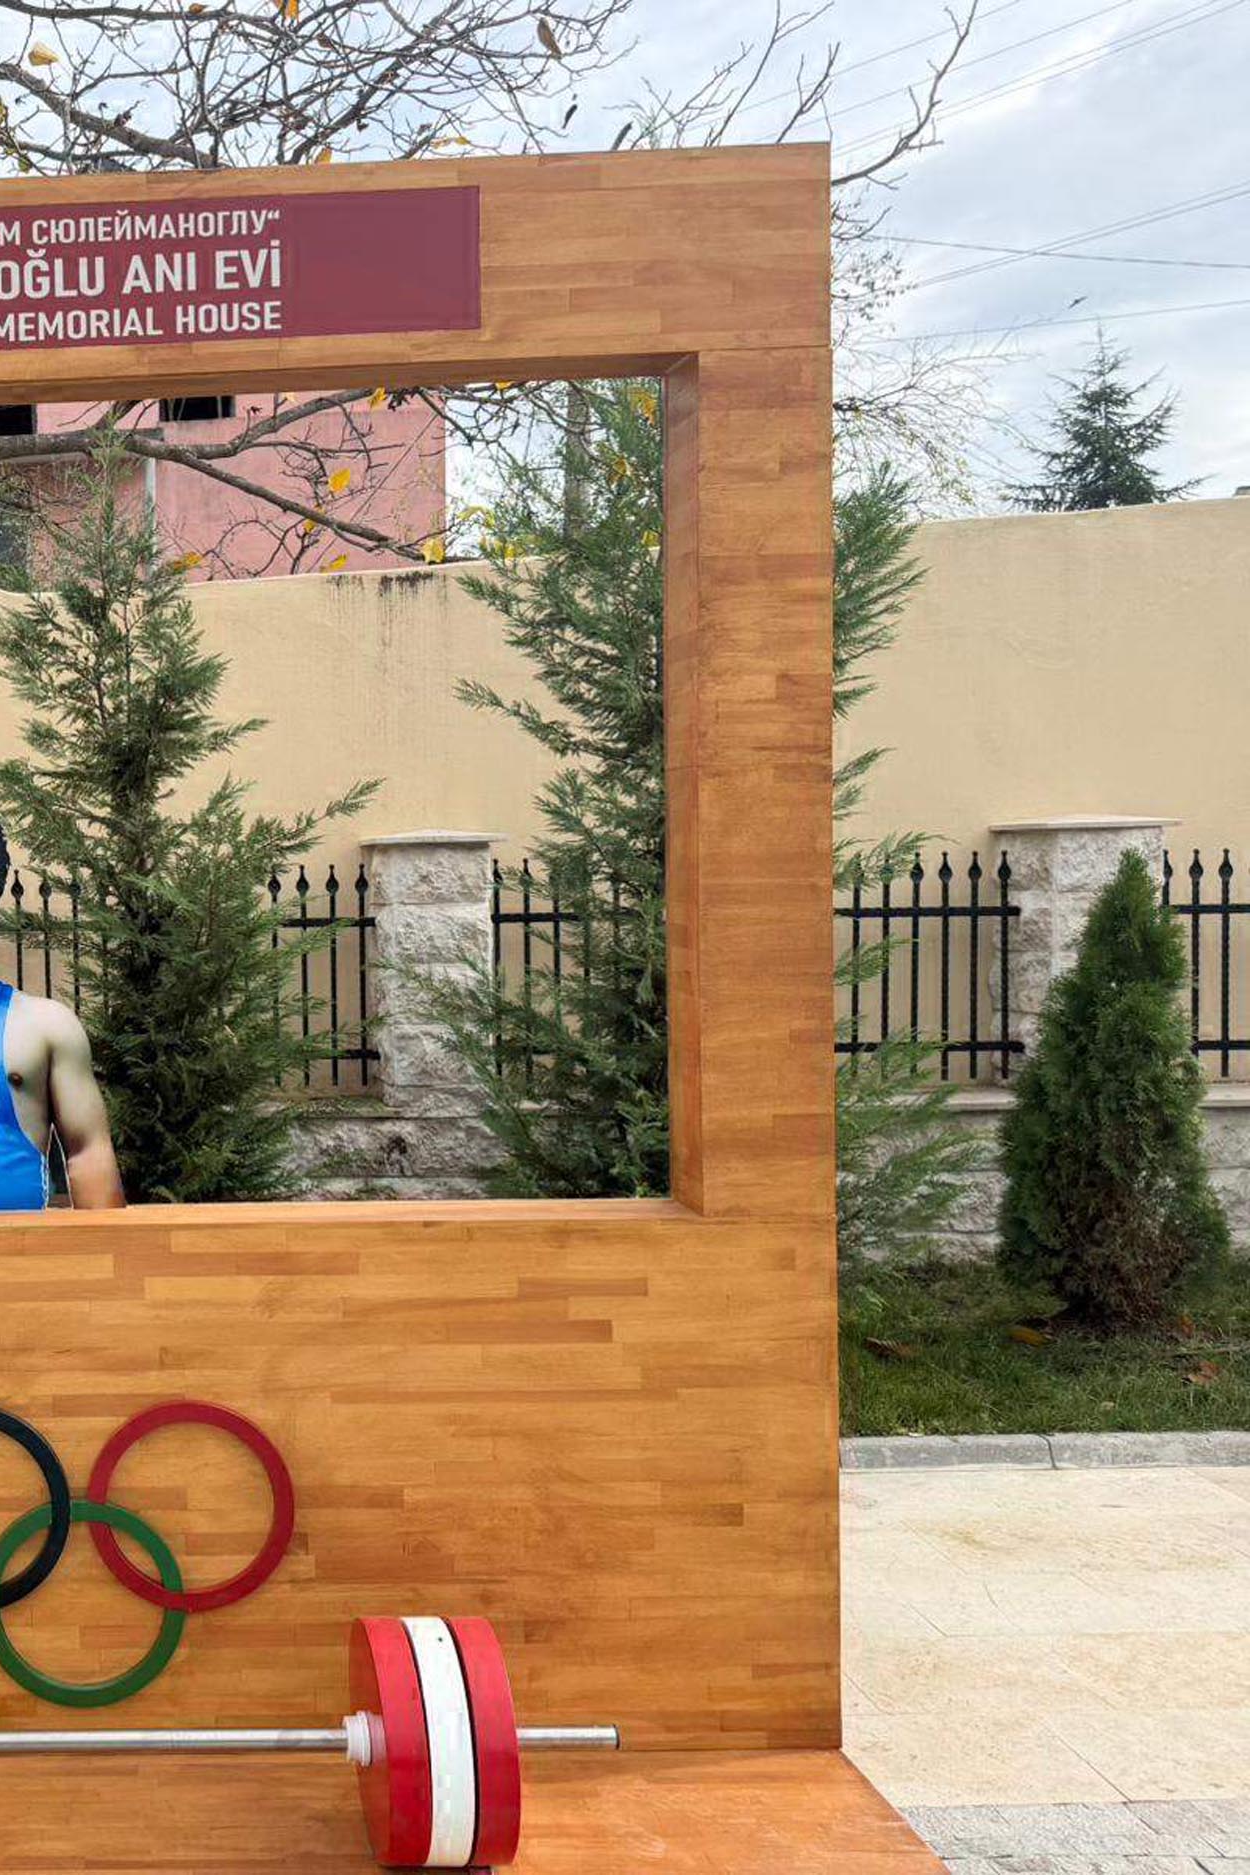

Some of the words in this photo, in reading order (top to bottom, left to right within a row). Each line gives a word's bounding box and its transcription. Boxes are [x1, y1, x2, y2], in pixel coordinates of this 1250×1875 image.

[121, 252, 197, 295] ANI
[215, 239, 281, 290] EVİ
[175, 300, 282, 334] HOUSE
